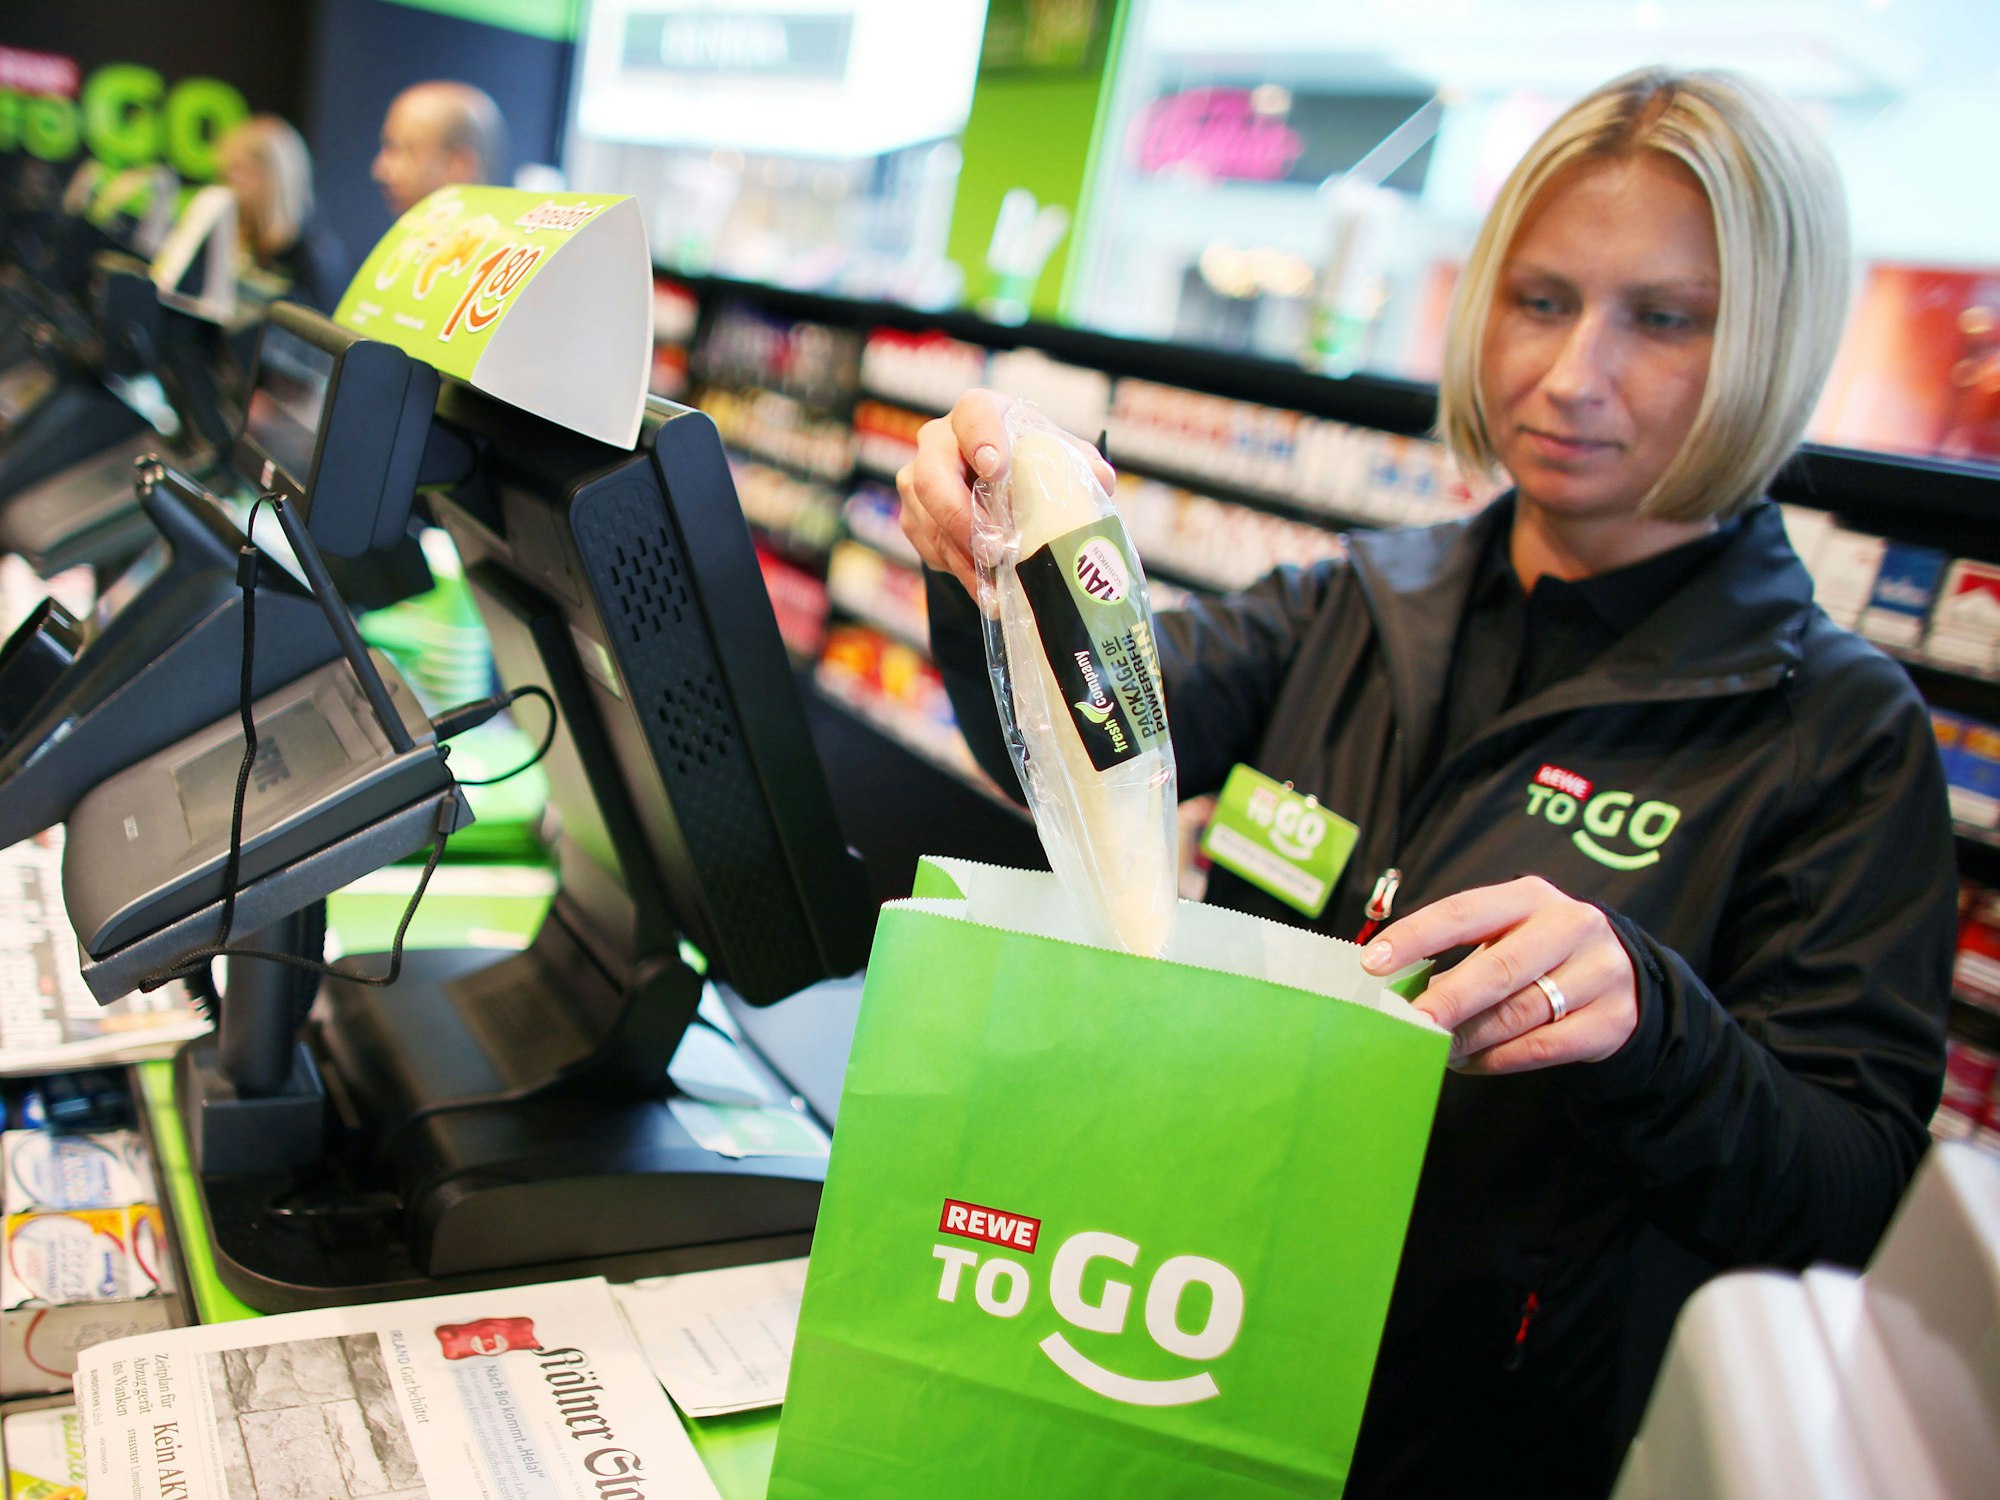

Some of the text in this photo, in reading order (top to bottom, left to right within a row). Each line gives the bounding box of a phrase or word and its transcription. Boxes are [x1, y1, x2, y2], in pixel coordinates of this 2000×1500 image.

[1093, 546, 1122, 586] SCHINKEN
[1074, 650, 1128, 753] fresh company
[1101, 639, 1156, 739] PACKAGE OF
[1537, 765, 1589, 799] REWE
[1276, 800, 1327, 849] GO
[1526, 783, 1681, 848] TO GO
[946, 1205, 1034, 1247] REWE
[932, 1231, 1243, 1360] TO GO
[112, 1360, 131, 1416] ins Wanken
[132, 1356, 153, 1415] Abzug gerät
[153, 1353, 176, 1408] Zeitplan für
[390, 1330, 429, 1424] IRLAND Gut behütet
[484, 1364, 503, 1388] Nach
[494, 1390, 508, 1405] Bio
[501, 1407, 528, 1442] kommt
[531, 1347, 614, 1441] Kölner
[127, 1428, 139, 1463] STRESSTEST
[153, 1421, 188, 1500] Kein AK
